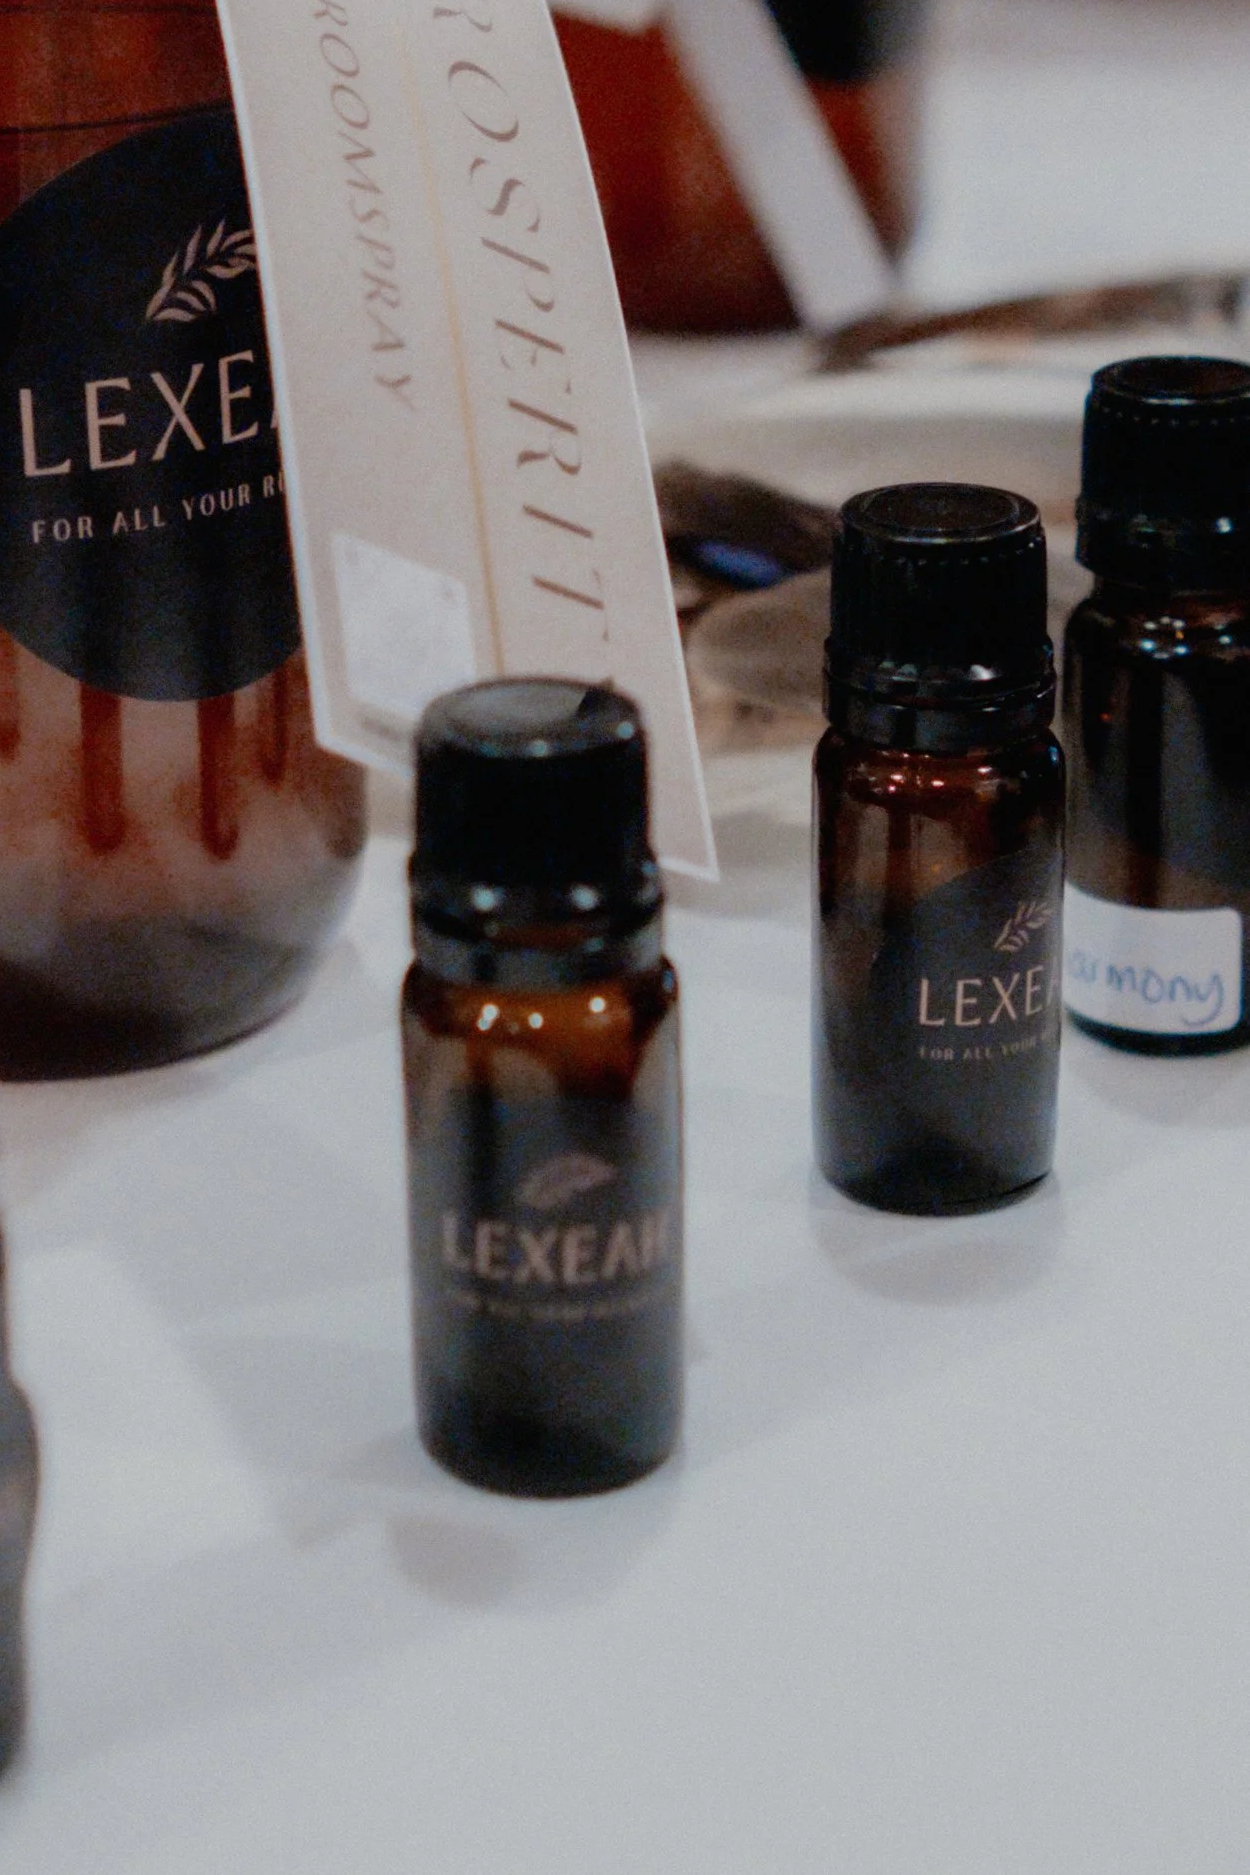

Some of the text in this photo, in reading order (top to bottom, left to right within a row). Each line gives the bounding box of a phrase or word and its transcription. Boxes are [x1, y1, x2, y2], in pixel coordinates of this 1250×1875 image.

[18, 348, 280, 478] LEXE
[31, 515, 94, 544] FOR
[111, 505, 167, 535] ALL
[181, 483, 251, 521] YOUR
